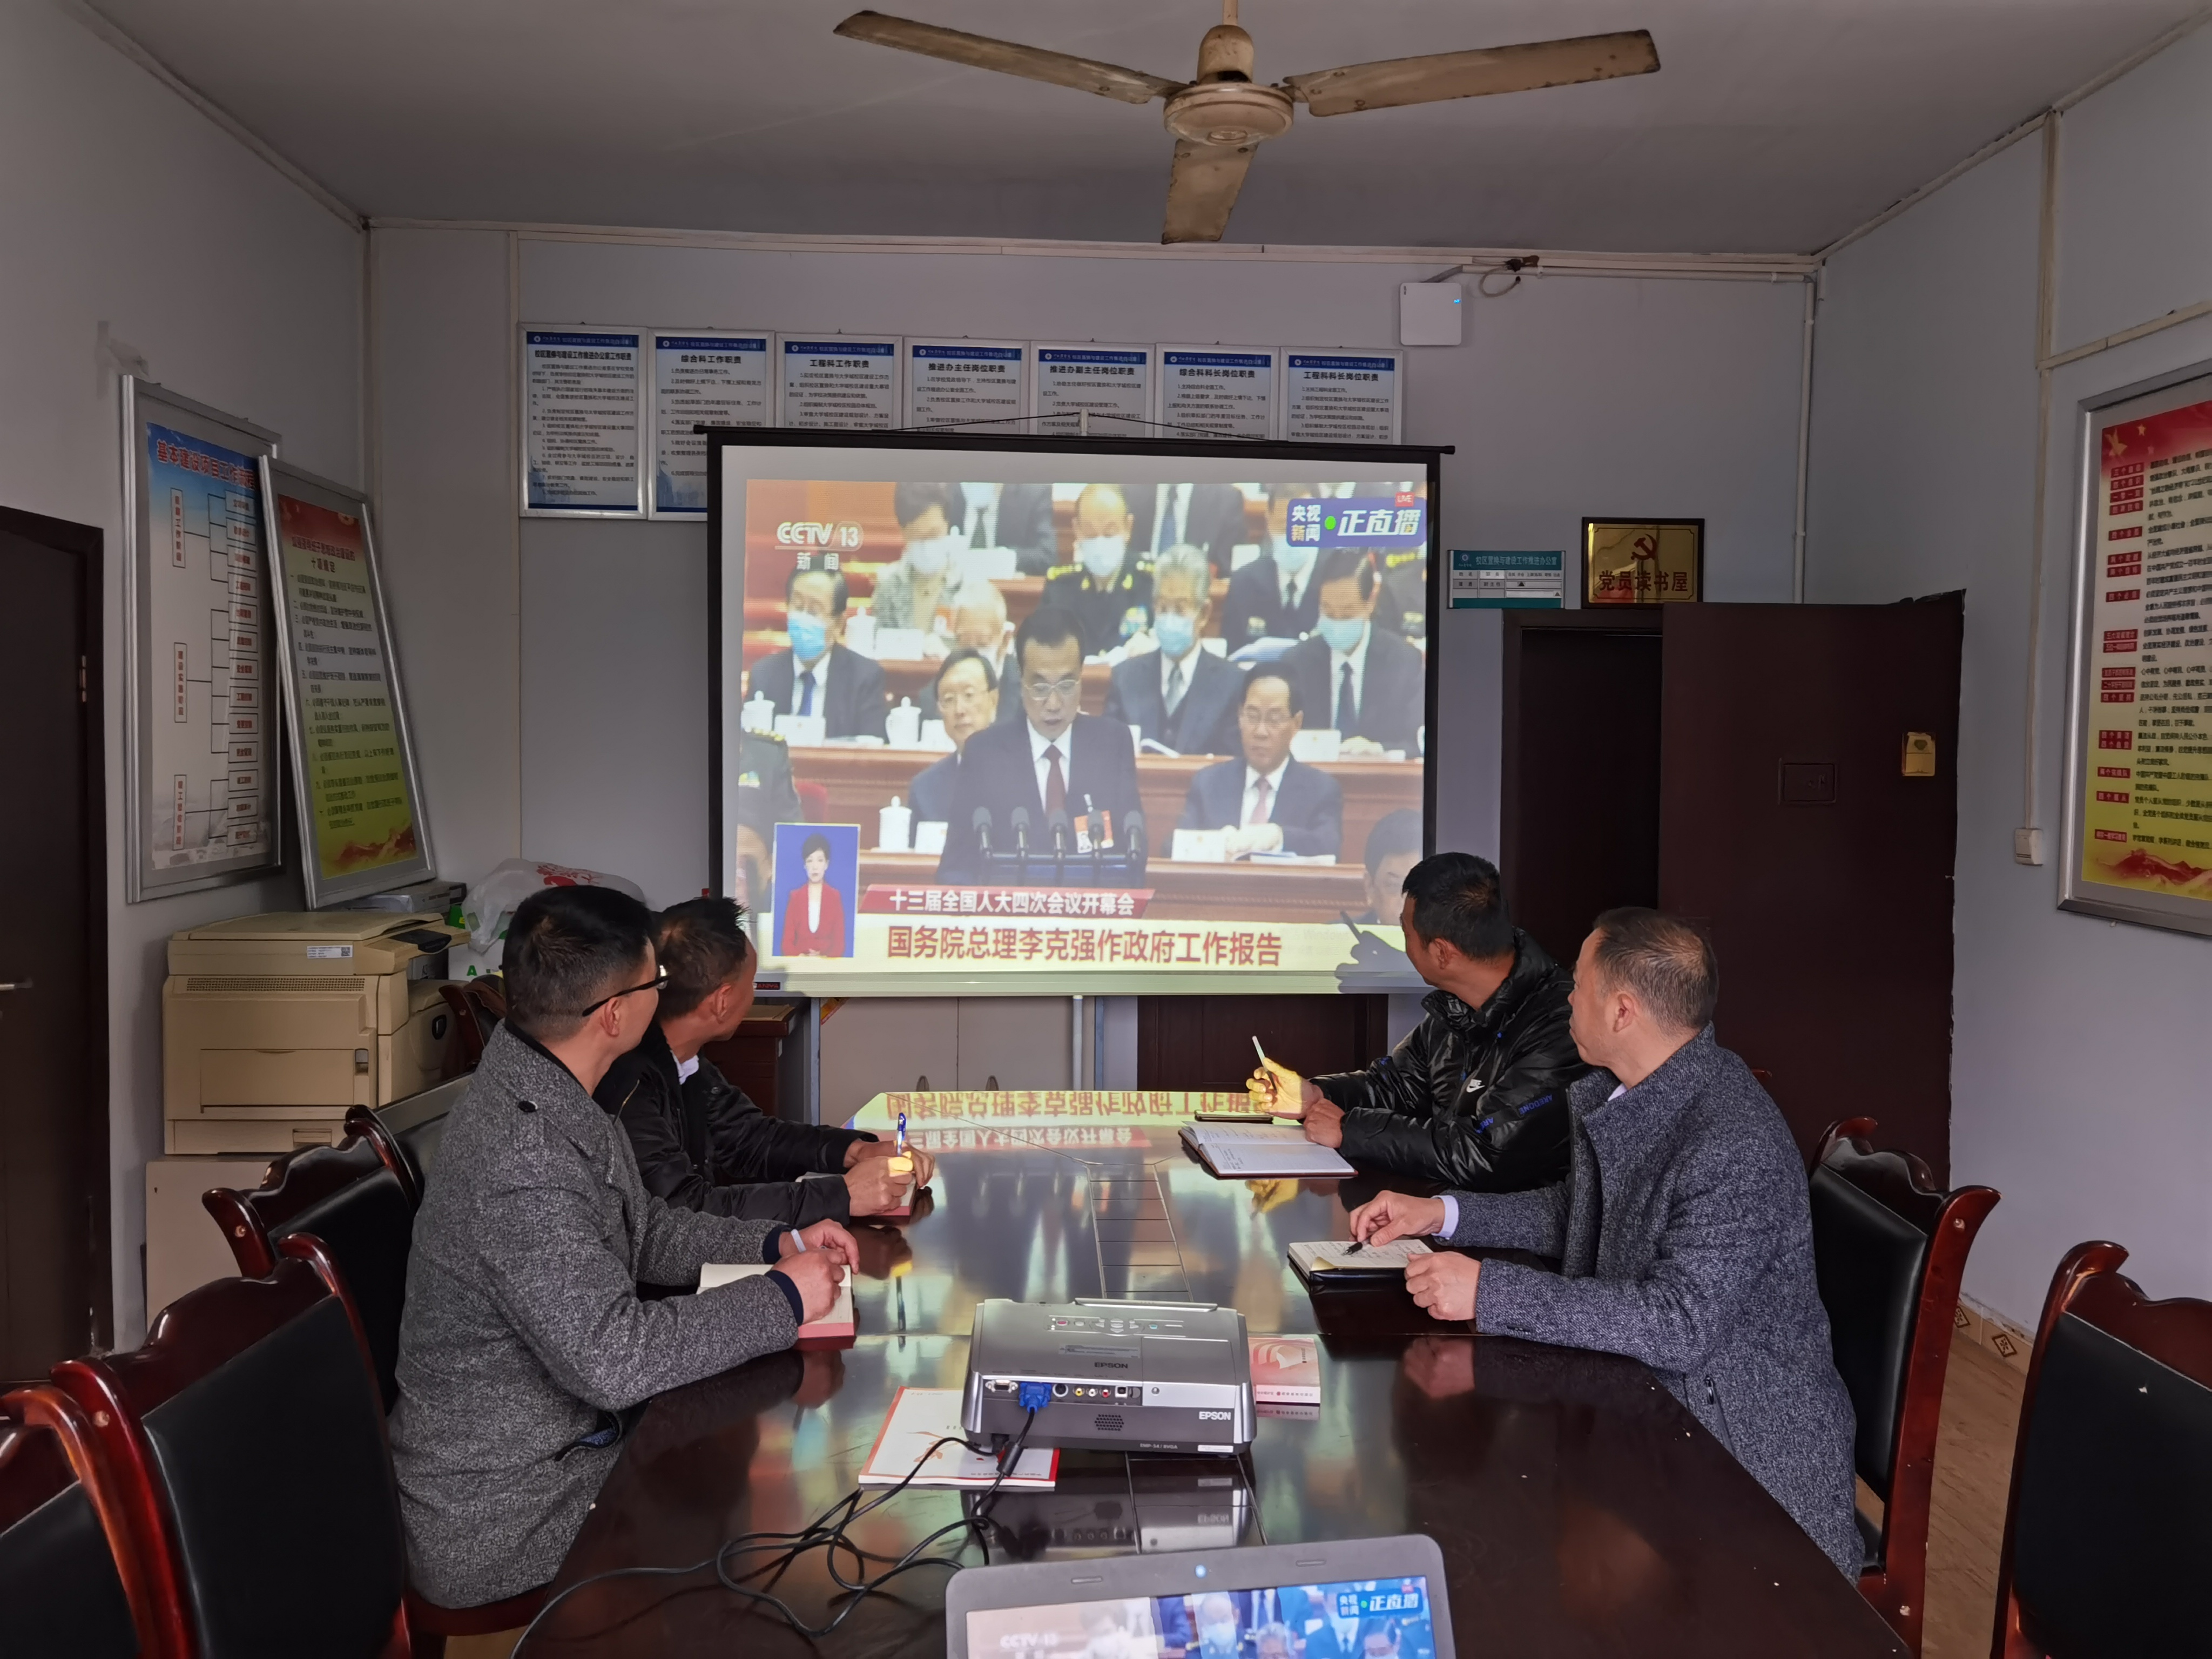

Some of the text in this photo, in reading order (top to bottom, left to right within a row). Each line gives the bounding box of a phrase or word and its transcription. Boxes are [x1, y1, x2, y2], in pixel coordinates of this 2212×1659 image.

[681, 355, 741, 364] 综合科工作职责
[810, 359, 869, 368] 工程科工作职责
[928, 363, 1006, 373] 推进办主任岗位职责
[1049, 366, 1135, 376] 推进办副主任岗位职责
[1179, 368, 1256, 378] 综合科科长岗位职责
[1304, 372, 1379, 382] 工程科科长岗位职责
[1292, 504, 1321, 522] 央视
[1337, 509, 1421, 536] 正直播
[777, 522, 859, 547] CCTV 13
[1291, 524, 1321, 542] 新闻
[797, 552, 839, 570] 新闻
[1599, 570, 1688, 592] 党员读书屋
[889, 888, 1134, 916] 十三届全国人大四次会议开幕会
[888, 925, 1282, 966] 国务院总理李克强作政府工作报告
[1198, 1411, 1231, 1421] EPSON
[1000, 1633, 1038, 1649] CCTV
